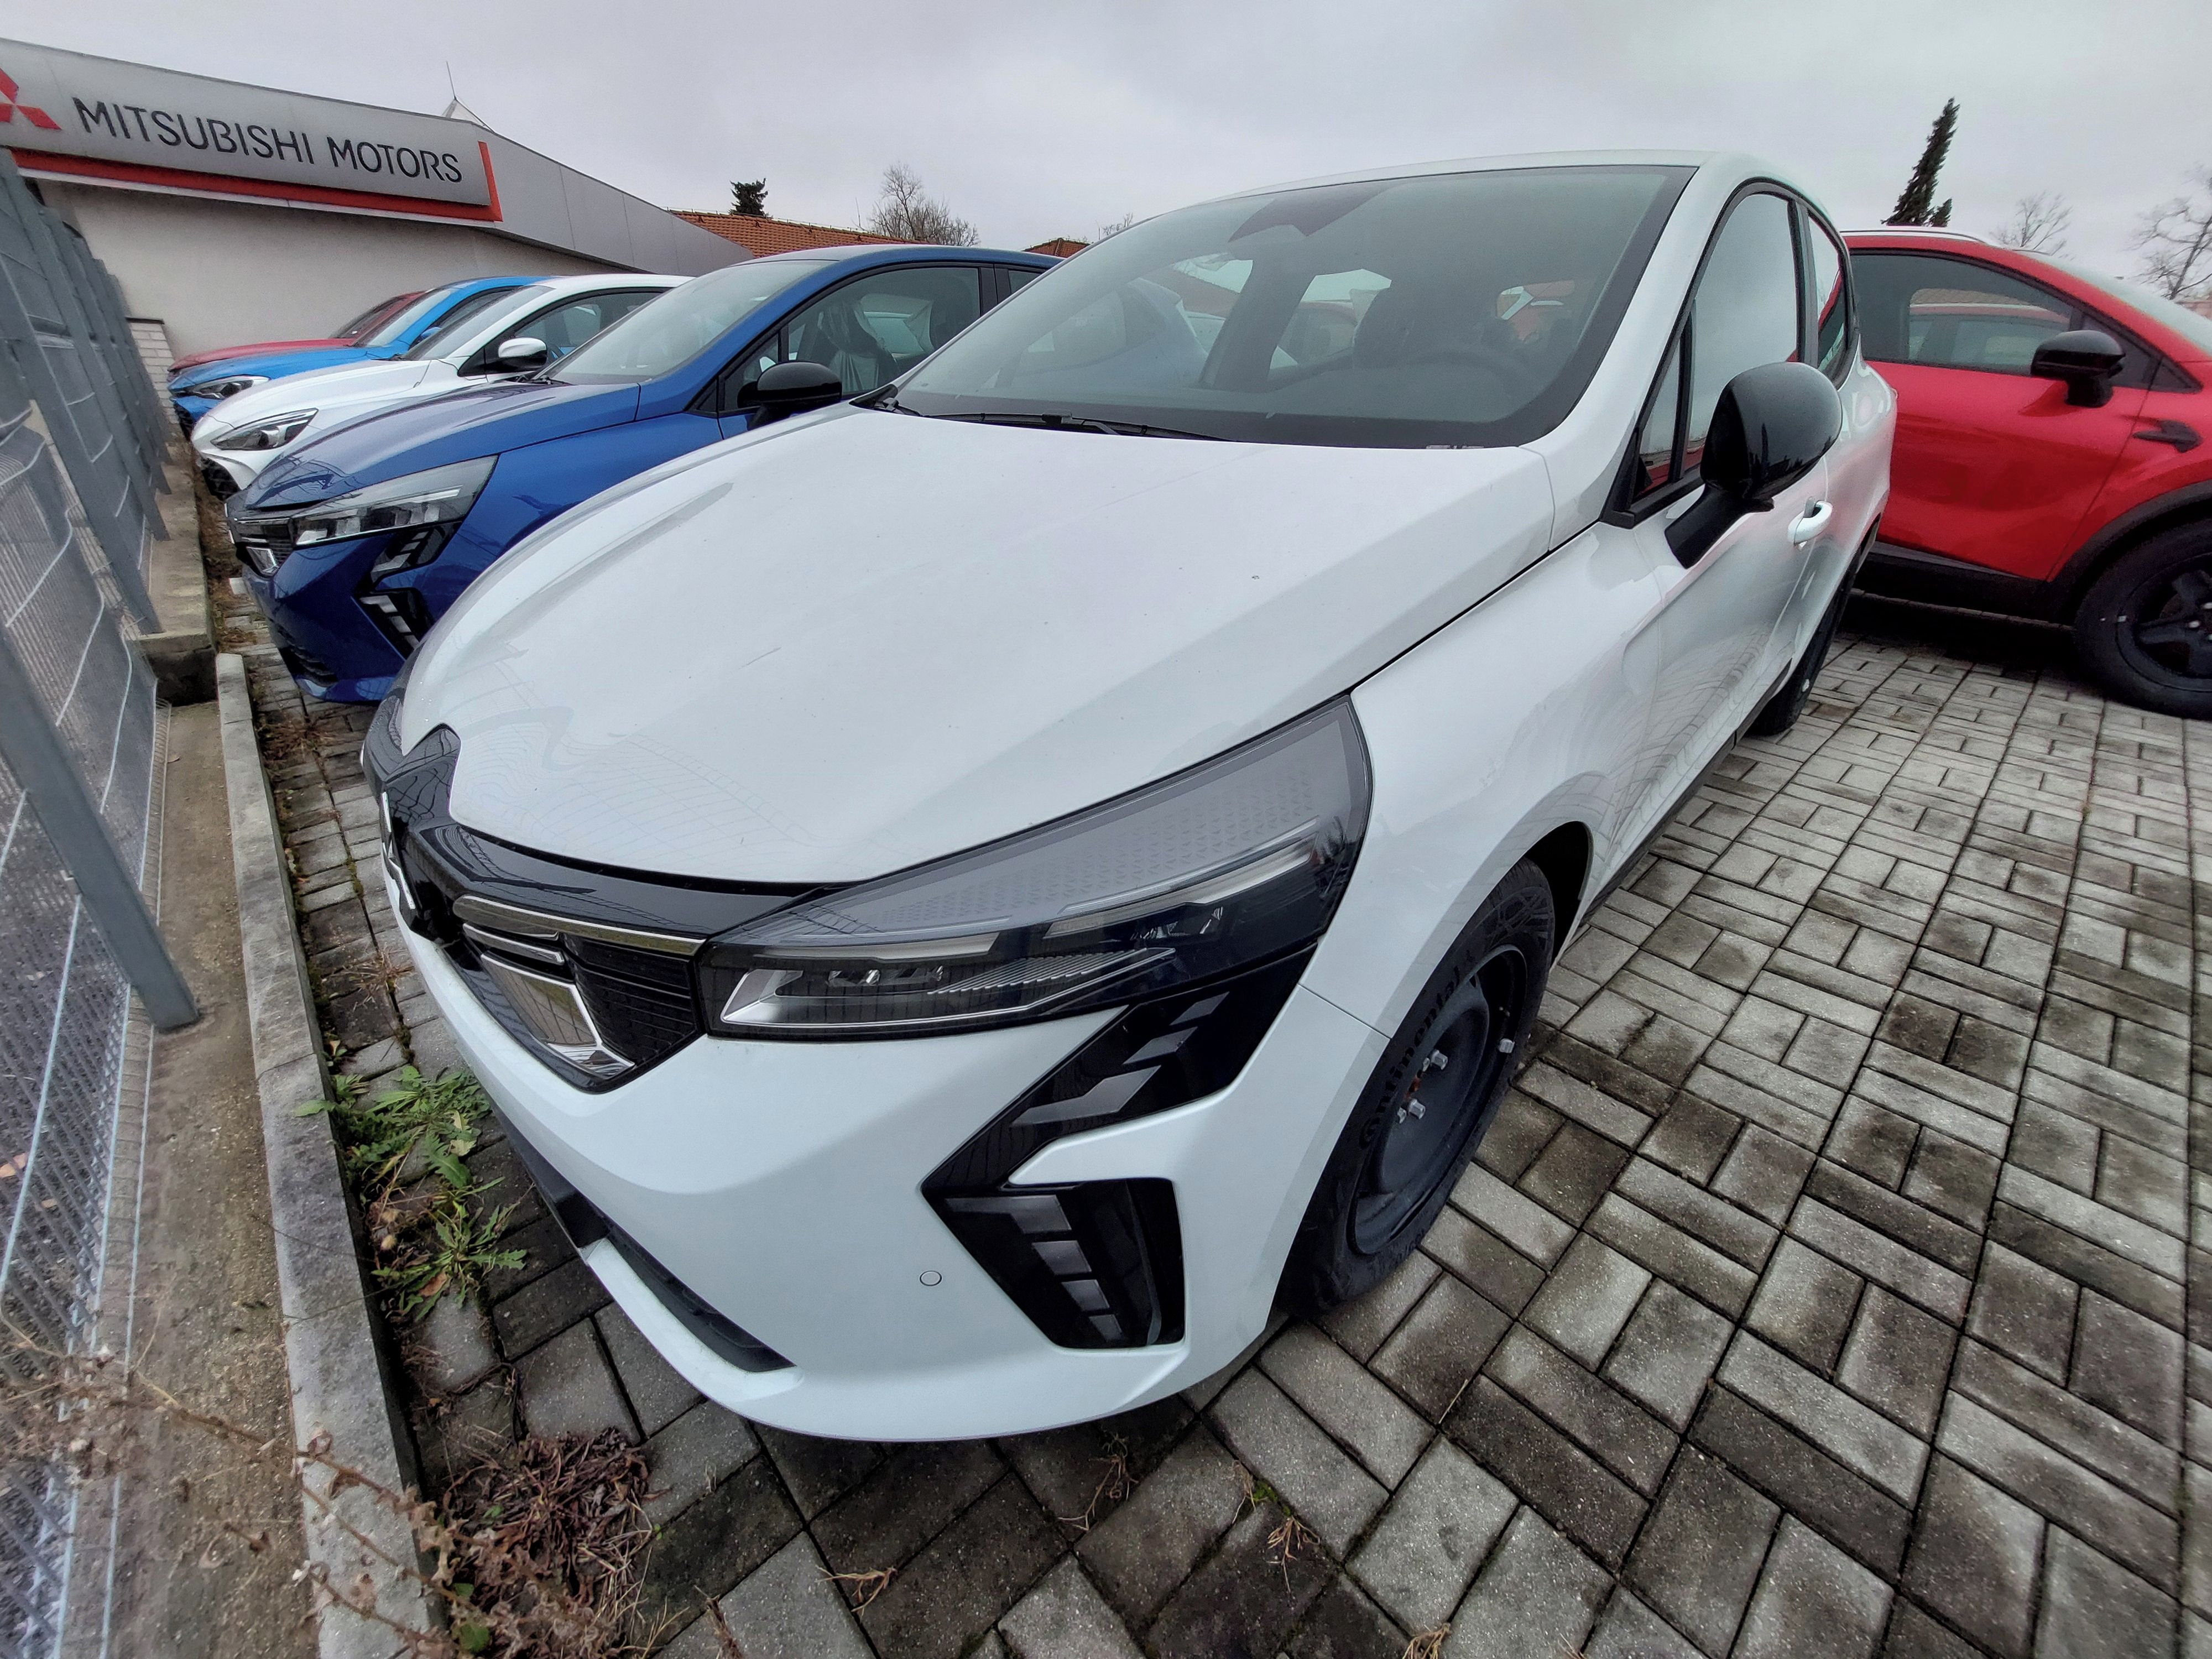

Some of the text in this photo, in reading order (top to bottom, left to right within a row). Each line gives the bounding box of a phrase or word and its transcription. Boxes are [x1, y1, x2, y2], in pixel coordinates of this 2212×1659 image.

[72, 97, 462, 183] MITSUBISHI MOTORS
[1359, 966, 1460, 1150] Continental
